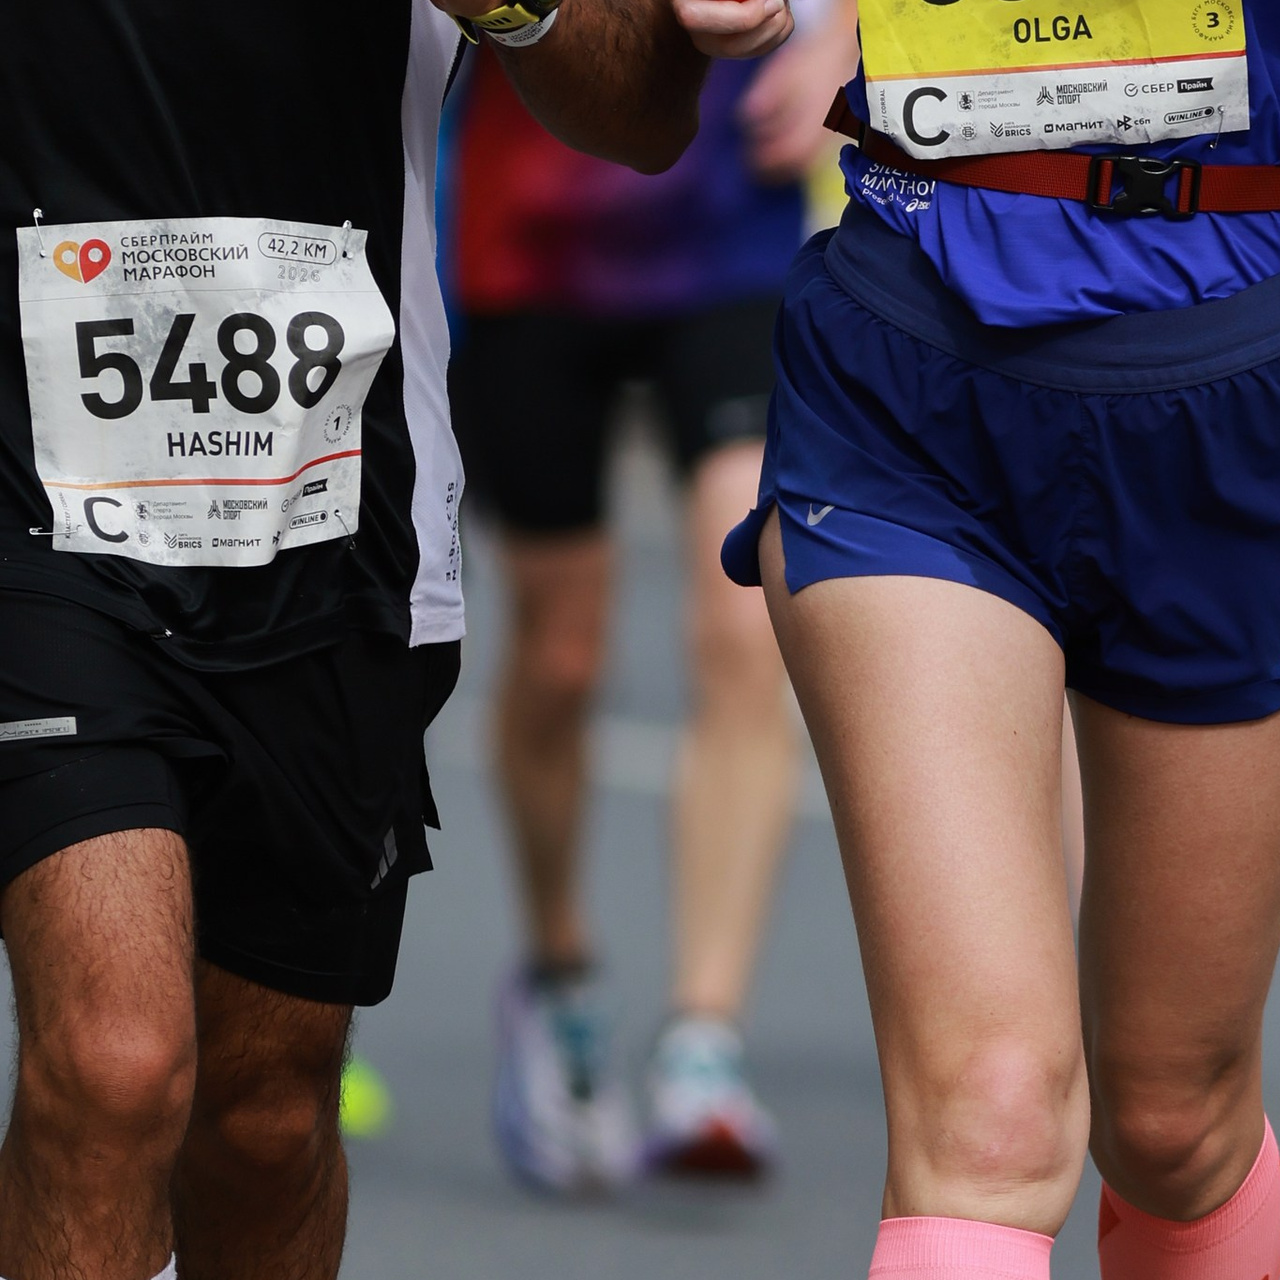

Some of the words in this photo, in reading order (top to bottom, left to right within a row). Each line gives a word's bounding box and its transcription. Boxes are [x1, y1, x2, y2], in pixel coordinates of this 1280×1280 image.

[1206, 12, 1220, 28] 3
[1013, 14, 1094, 44] OLGA
[1056, 80, 1108, 95] МОСКОВСКИЙ
[1141, 82, 1174, 94] СБЕР
[1180, 81, 1208, 91] Прайм
[1057, 94, 1081, 105] СПОРТ
[1168, 111, 1203, 122] WINLINE
[121, 232, 213, 247] СБЕРПРАЙМ
[268, 238, 299, 256] 42,2
[122, 244, 249, 265] МОСКОВСКИЙ
[123, 265, 215, 282] МАРАФОН
[278, 265, 321, 282] 2026
[75, 311, 346, 419] 5488
[333, 416, 341, 431] 1
[167, 432, 274, 457] HASHIM
[222, 498, 268, 510] МОСКОВСКИЙ
[223, 510, 241, 520] СПОРТ
[292, 514, 319, 526] WINLINE
[178, 541, 202, 549] BRICS
